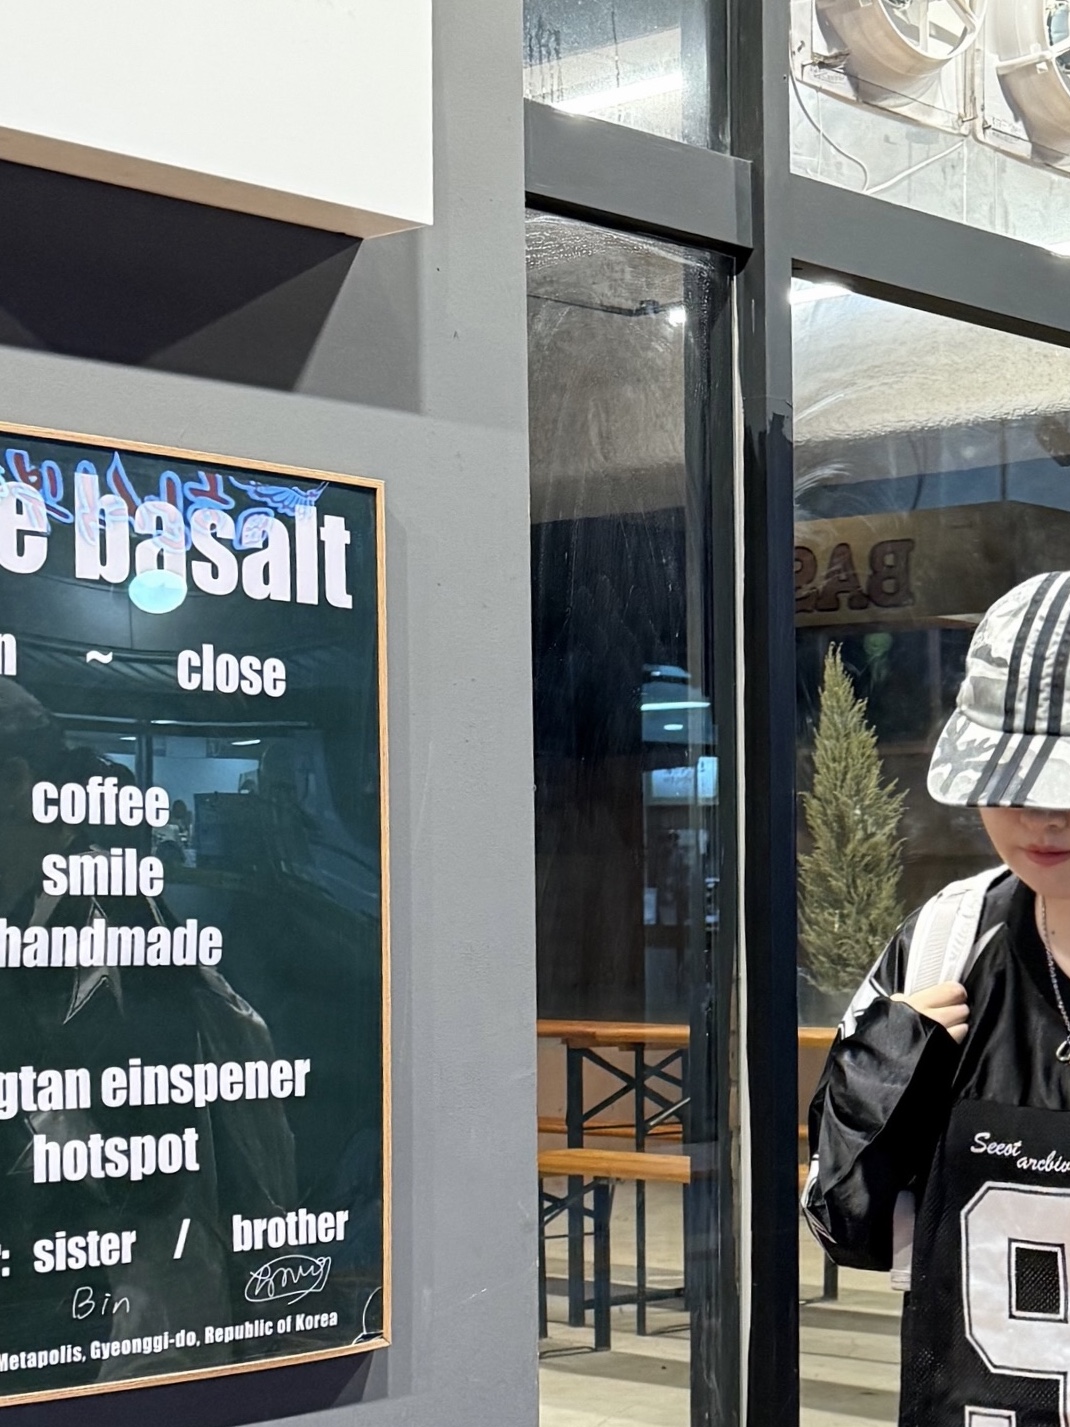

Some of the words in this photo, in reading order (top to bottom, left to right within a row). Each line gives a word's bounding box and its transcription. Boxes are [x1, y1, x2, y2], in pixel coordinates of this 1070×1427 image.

[74, 472, 353, 609] basalt
[177, 644, 287, 697] close
[32, 775, 170, 828] coffee
[42, 848, 164, 897] smile
[0, 918, 223, 968] handmade
[101, 1059, 311, 1108] einspener
[33, 1128, 200, 1184] hotspot
[33, 1230, 137, 1273] sister
[232, 1209, 350, 1252] brother
[72, 1286, 130, 1320] Bin
[90, 1330, 201, 1361] Gyeonggi-do,
[204, 1319, 275, 1345] Republic
[276, 1315, 293, 1335] of
[295, 1311, 339, 1332] Korea
